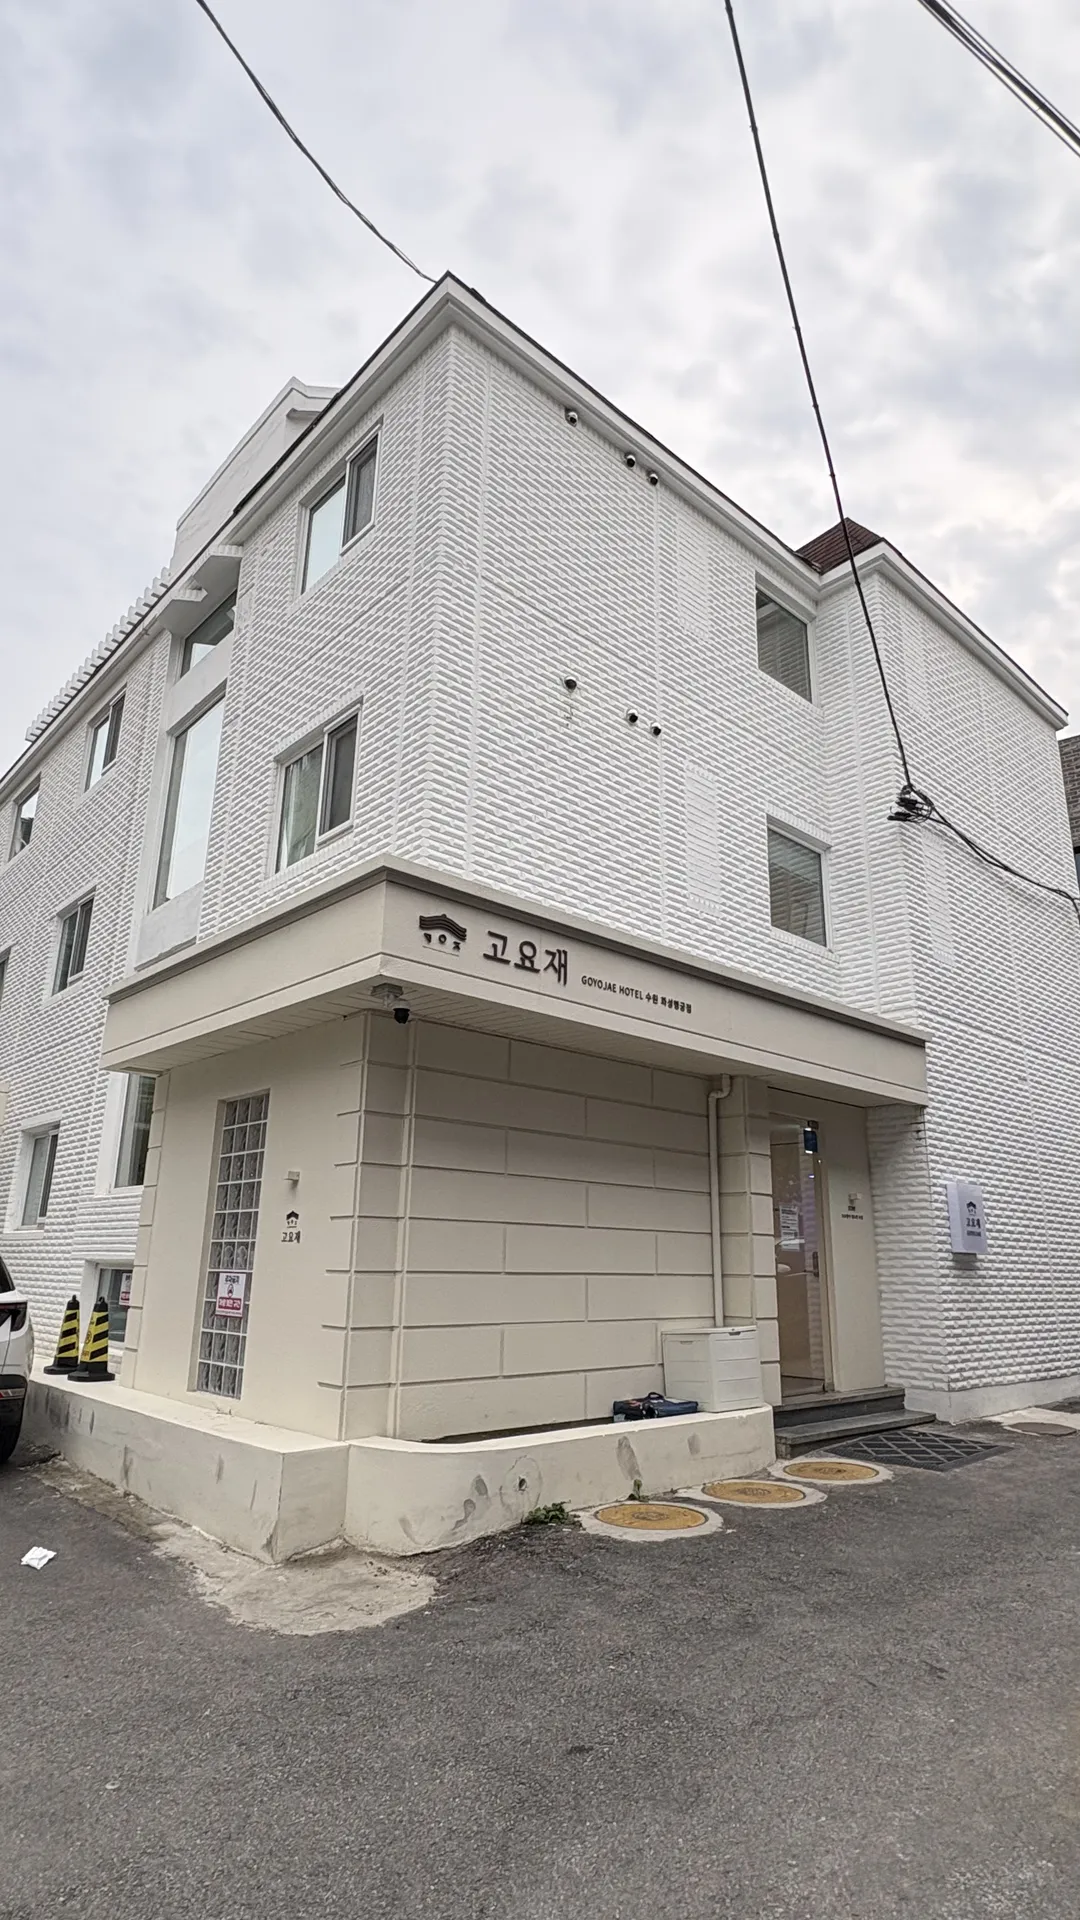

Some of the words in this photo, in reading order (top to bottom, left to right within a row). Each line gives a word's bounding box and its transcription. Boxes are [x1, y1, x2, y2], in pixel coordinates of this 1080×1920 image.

[483, 930, 569, 986] 고요재
[581, 975, 617, 993] GOYOJAE
[619, 985, 643, 1000] HOTEL
[645, 992, 658, 1005] 수원
[660, 996, 692, 1014] 화성행궁점
[281, 1231, 301, 1244] 고요재
